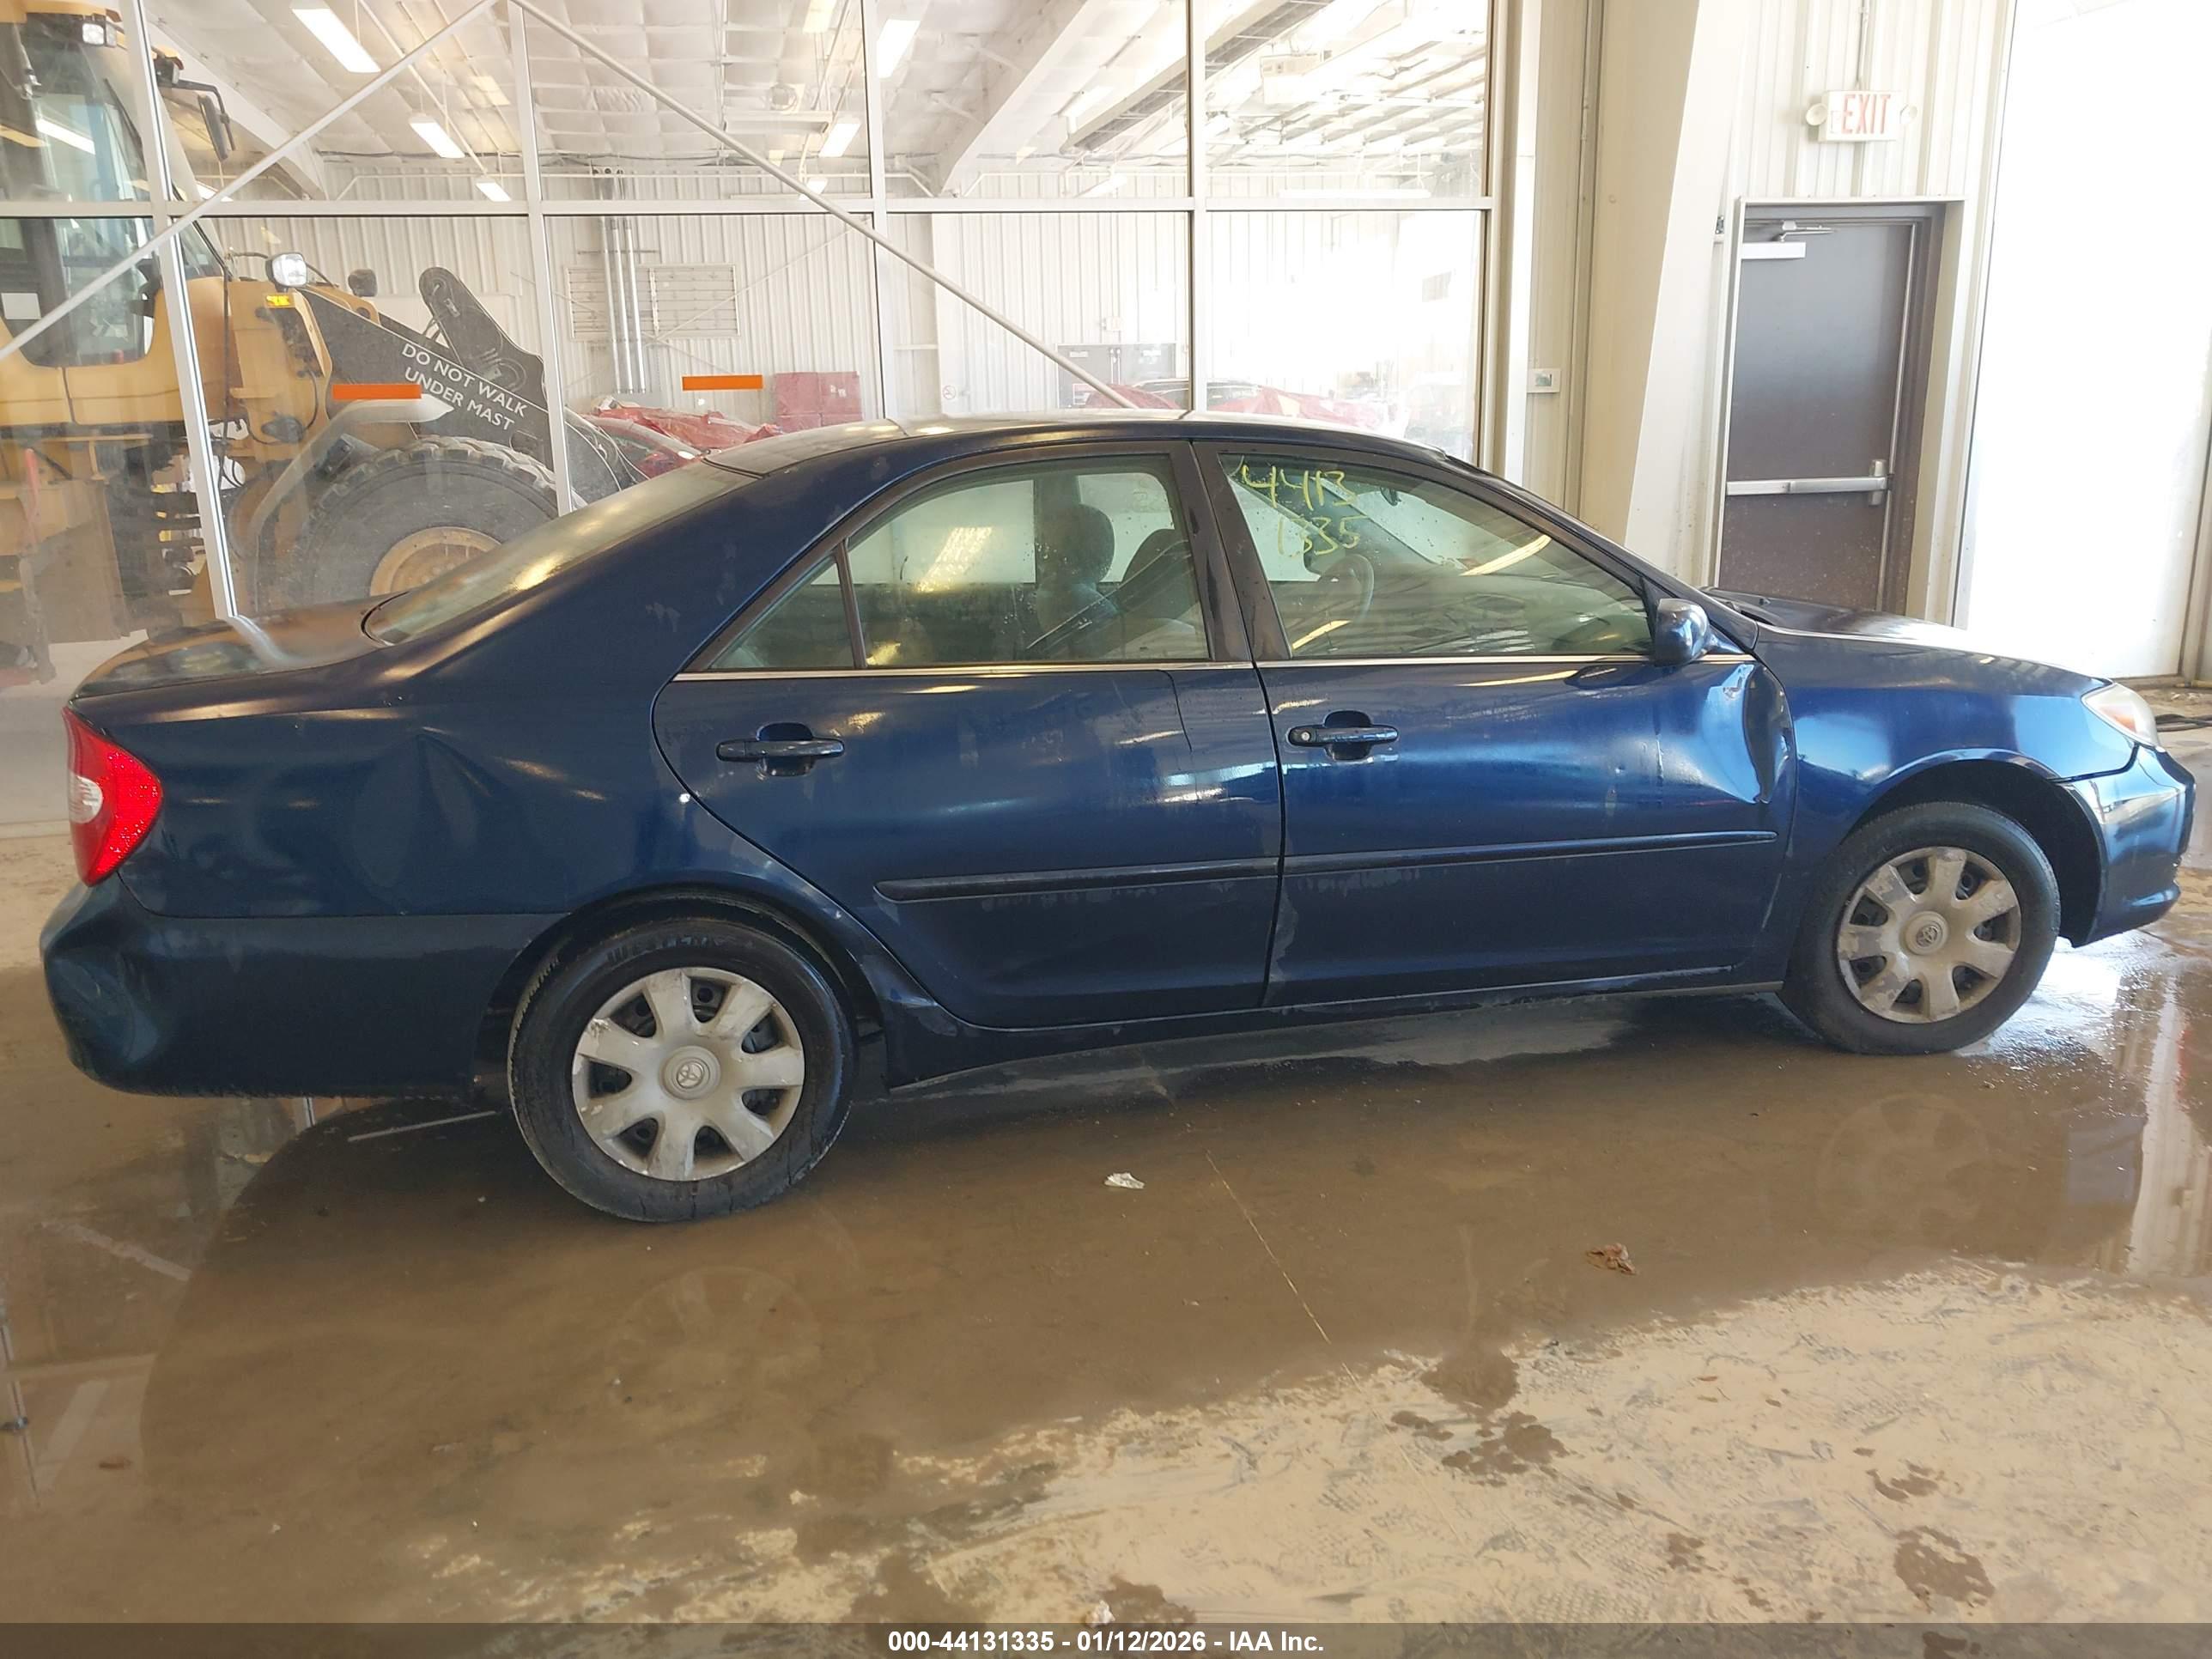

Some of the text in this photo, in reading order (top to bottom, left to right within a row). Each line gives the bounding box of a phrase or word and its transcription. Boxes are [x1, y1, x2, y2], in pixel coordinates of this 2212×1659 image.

[1841, 94, 1891, 134] EXIT
[402, 343, 528, 417] DO NOT WALK
[404, 367, 514, 430] UNDER MAST
[1242, 465, 1358, 511] 4413
